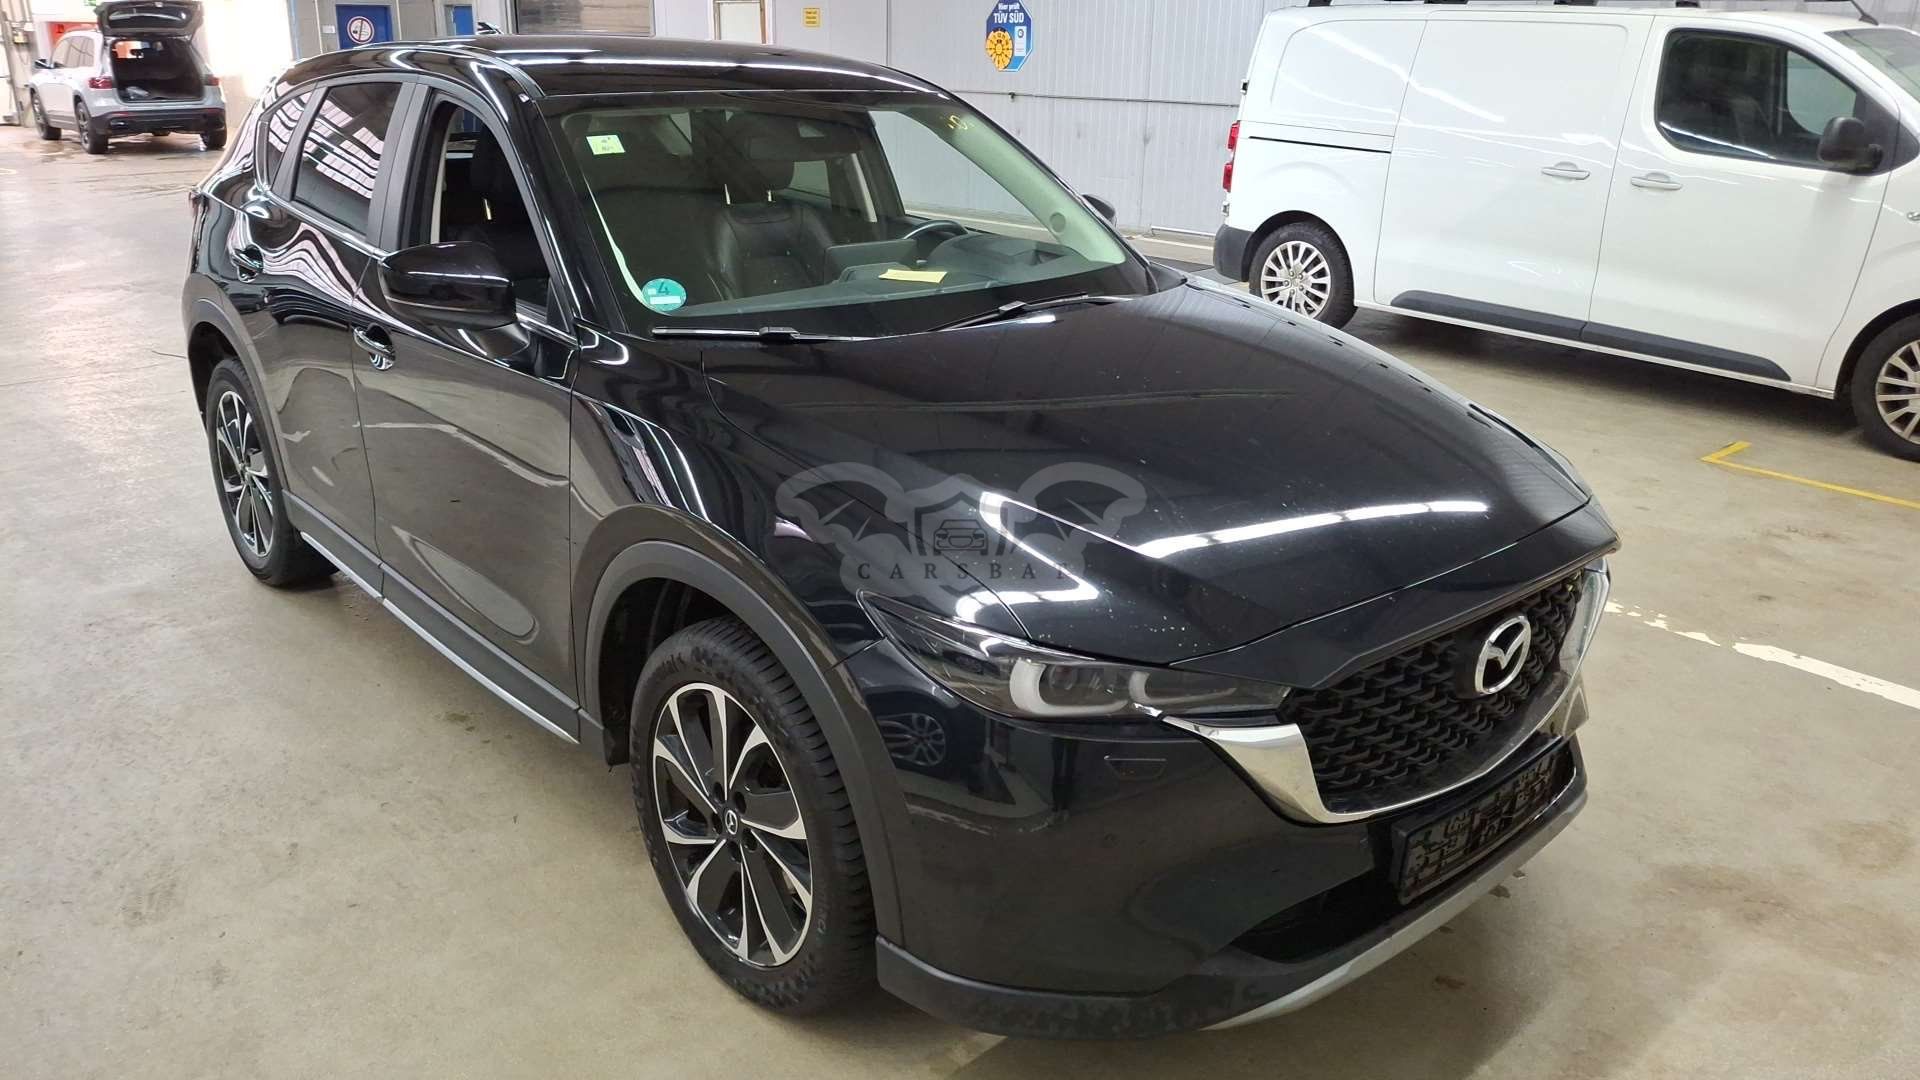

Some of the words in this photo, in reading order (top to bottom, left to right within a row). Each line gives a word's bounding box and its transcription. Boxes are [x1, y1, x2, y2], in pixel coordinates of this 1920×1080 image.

[993, 10, 1008, 23] TÜV
[1009, 10, 1024, 23] SÜD
[658, 281, 671, 295] 4
